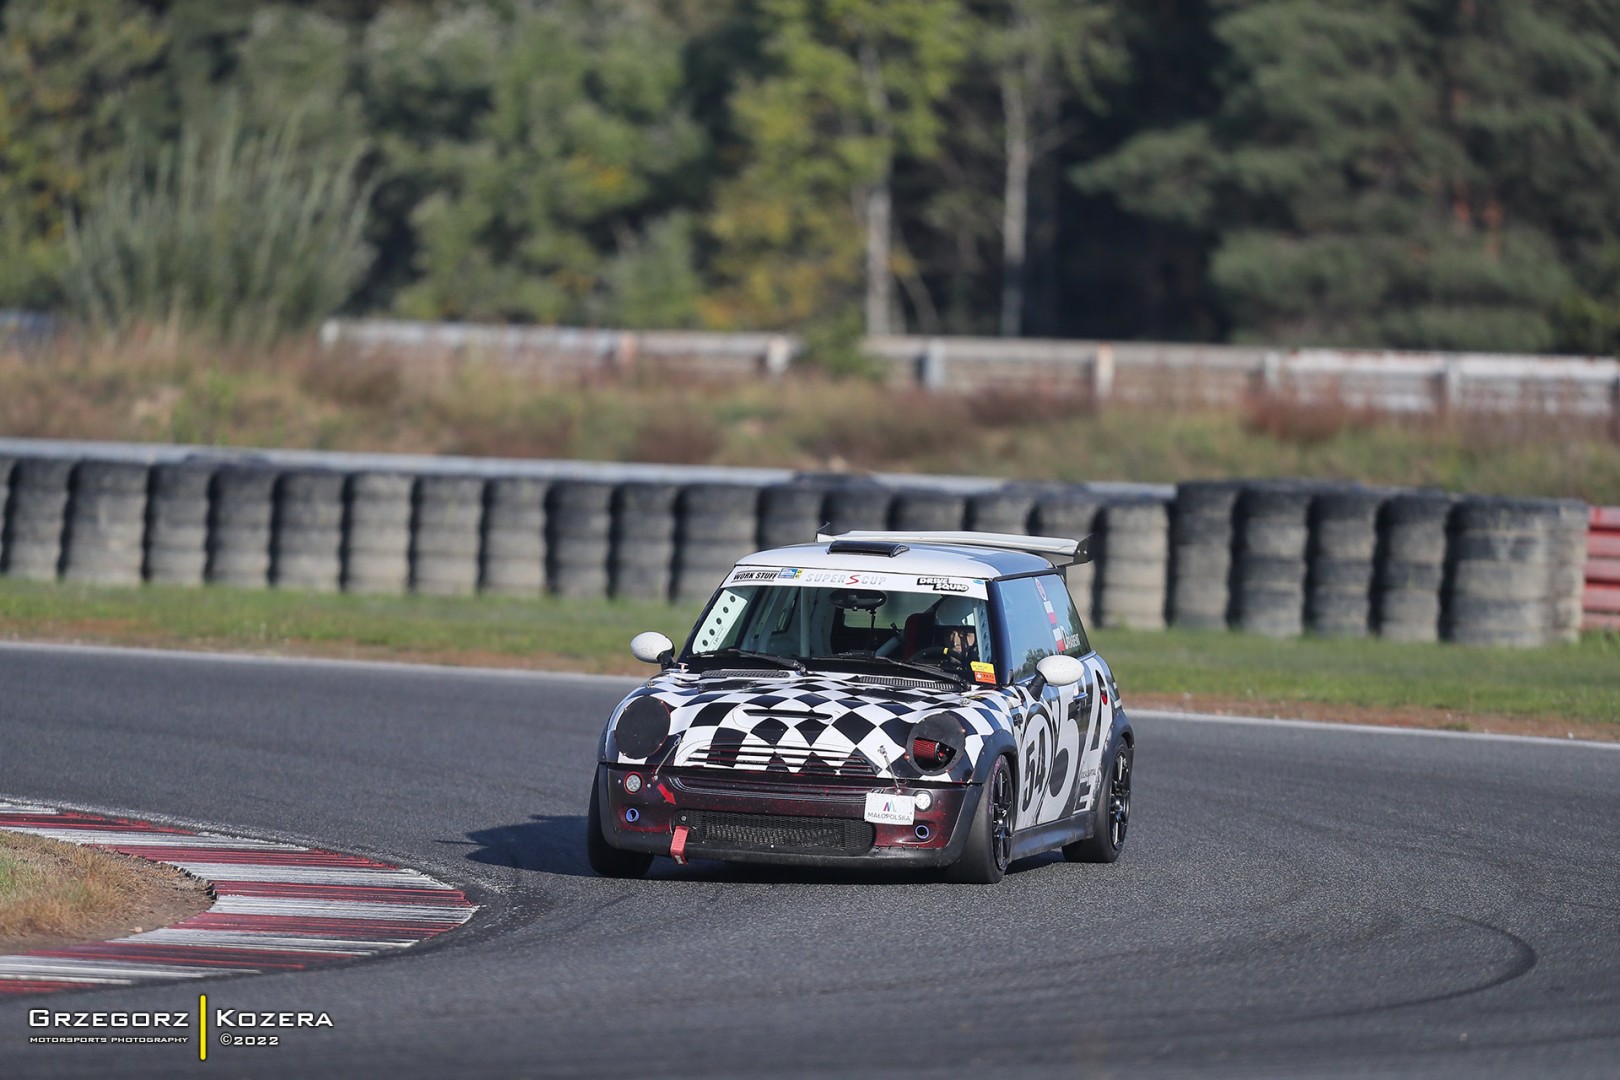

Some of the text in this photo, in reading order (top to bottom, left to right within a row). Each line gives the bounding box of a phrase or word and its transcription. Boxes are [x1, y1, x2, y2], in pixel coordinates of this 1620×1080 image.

[733, 572, 755, 580] WORK
[755, 572, 778, 580] STUFF
[806, 574, 846, 583] SUPER
[861, 575, 887, 585] CUP
[917, 577, 949, 585] DRIVE
[934, 583, 969, 592] SQUAD
[1022, 727, 1046, 812] 54
[867, 812, 911, 822] MAŁOPOLSKA
